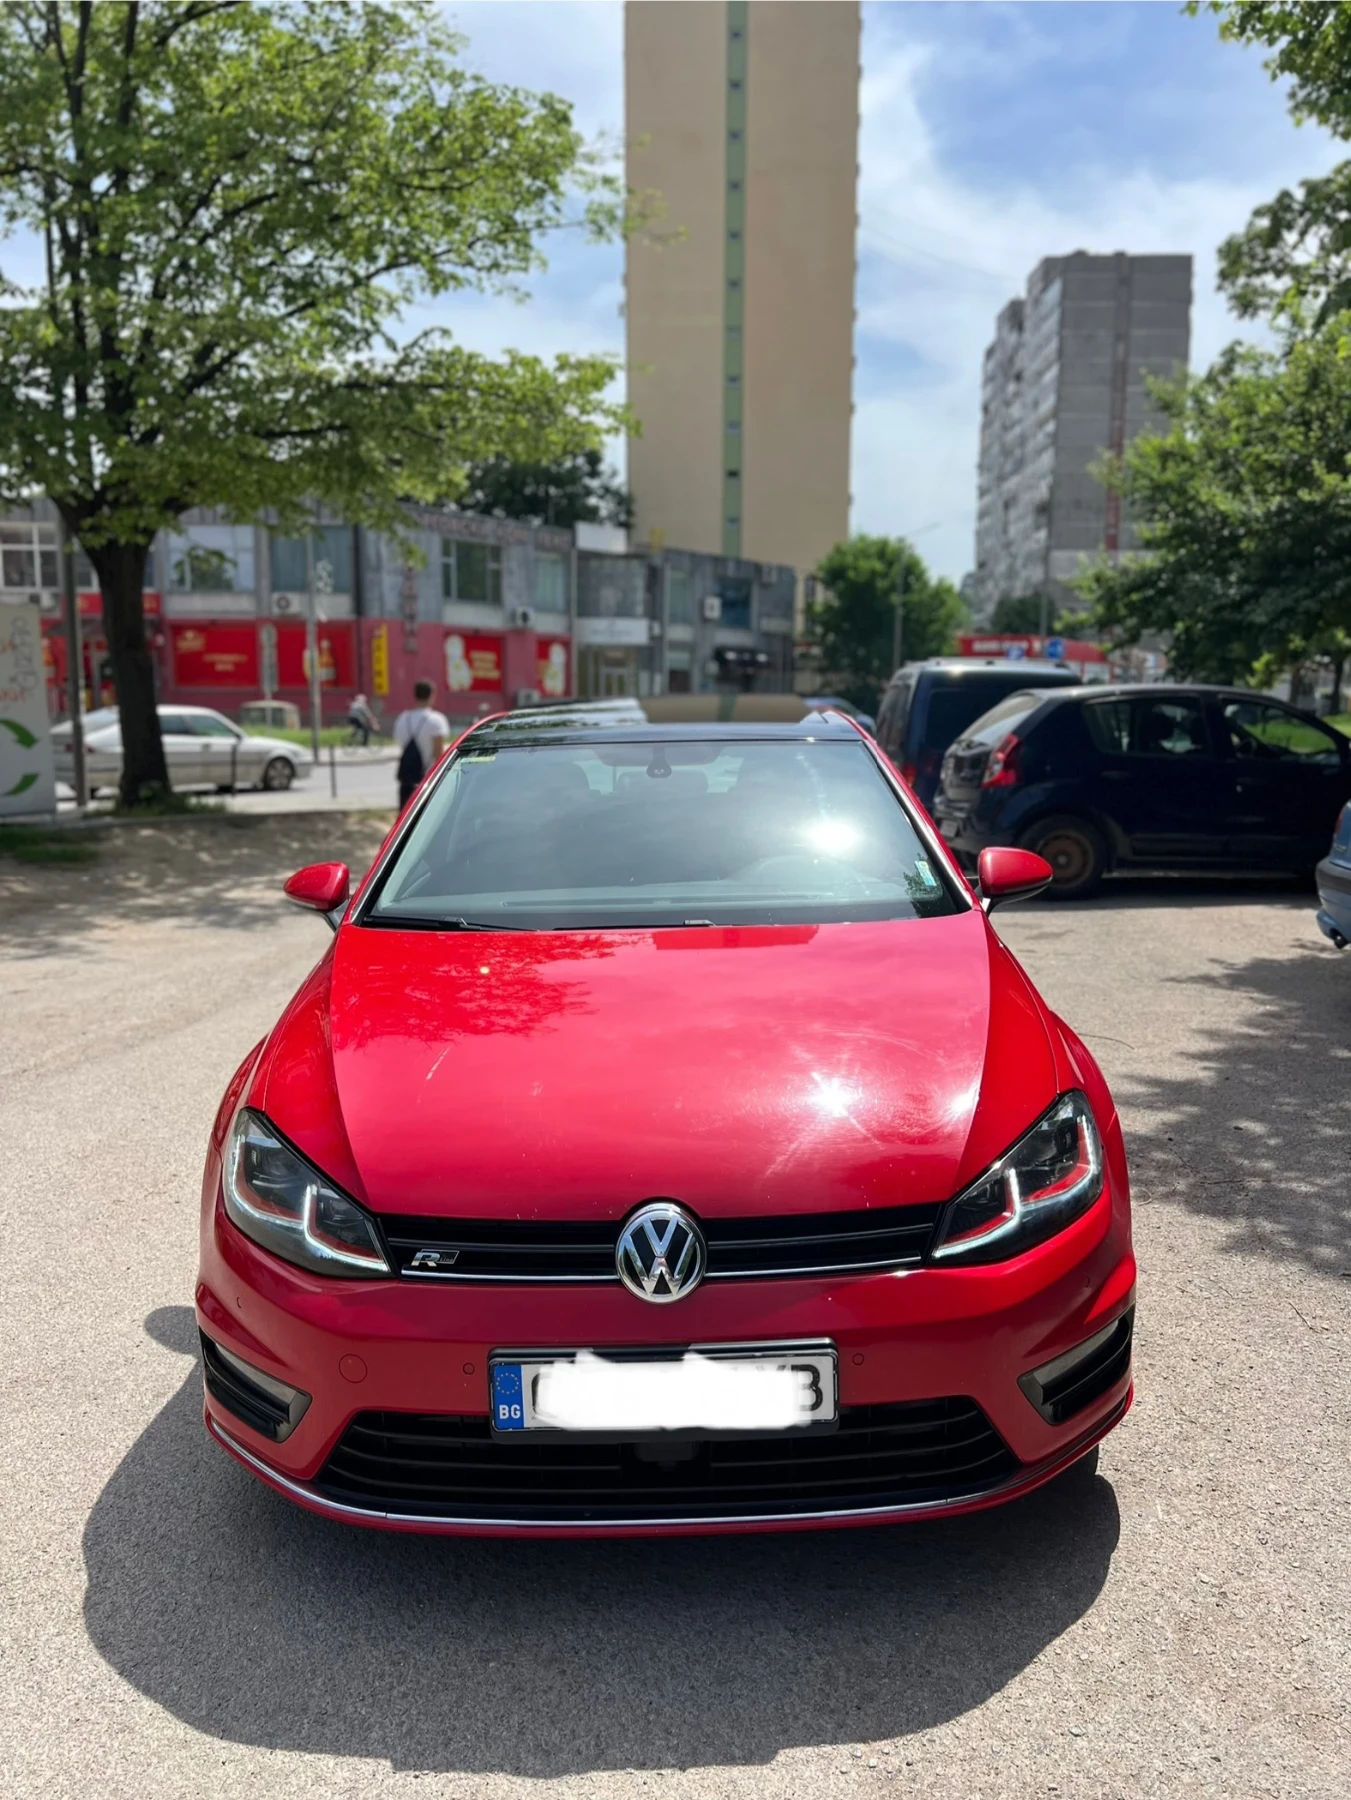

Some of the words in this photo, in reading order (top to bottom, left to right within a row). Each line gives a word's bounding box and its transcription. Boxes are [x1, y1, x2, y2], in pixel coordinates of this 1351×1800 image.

[411, 1252, 440, 1266] R
[618, 1206, 704, 1302] VW
[499, 1404, 521, 1419] BG
